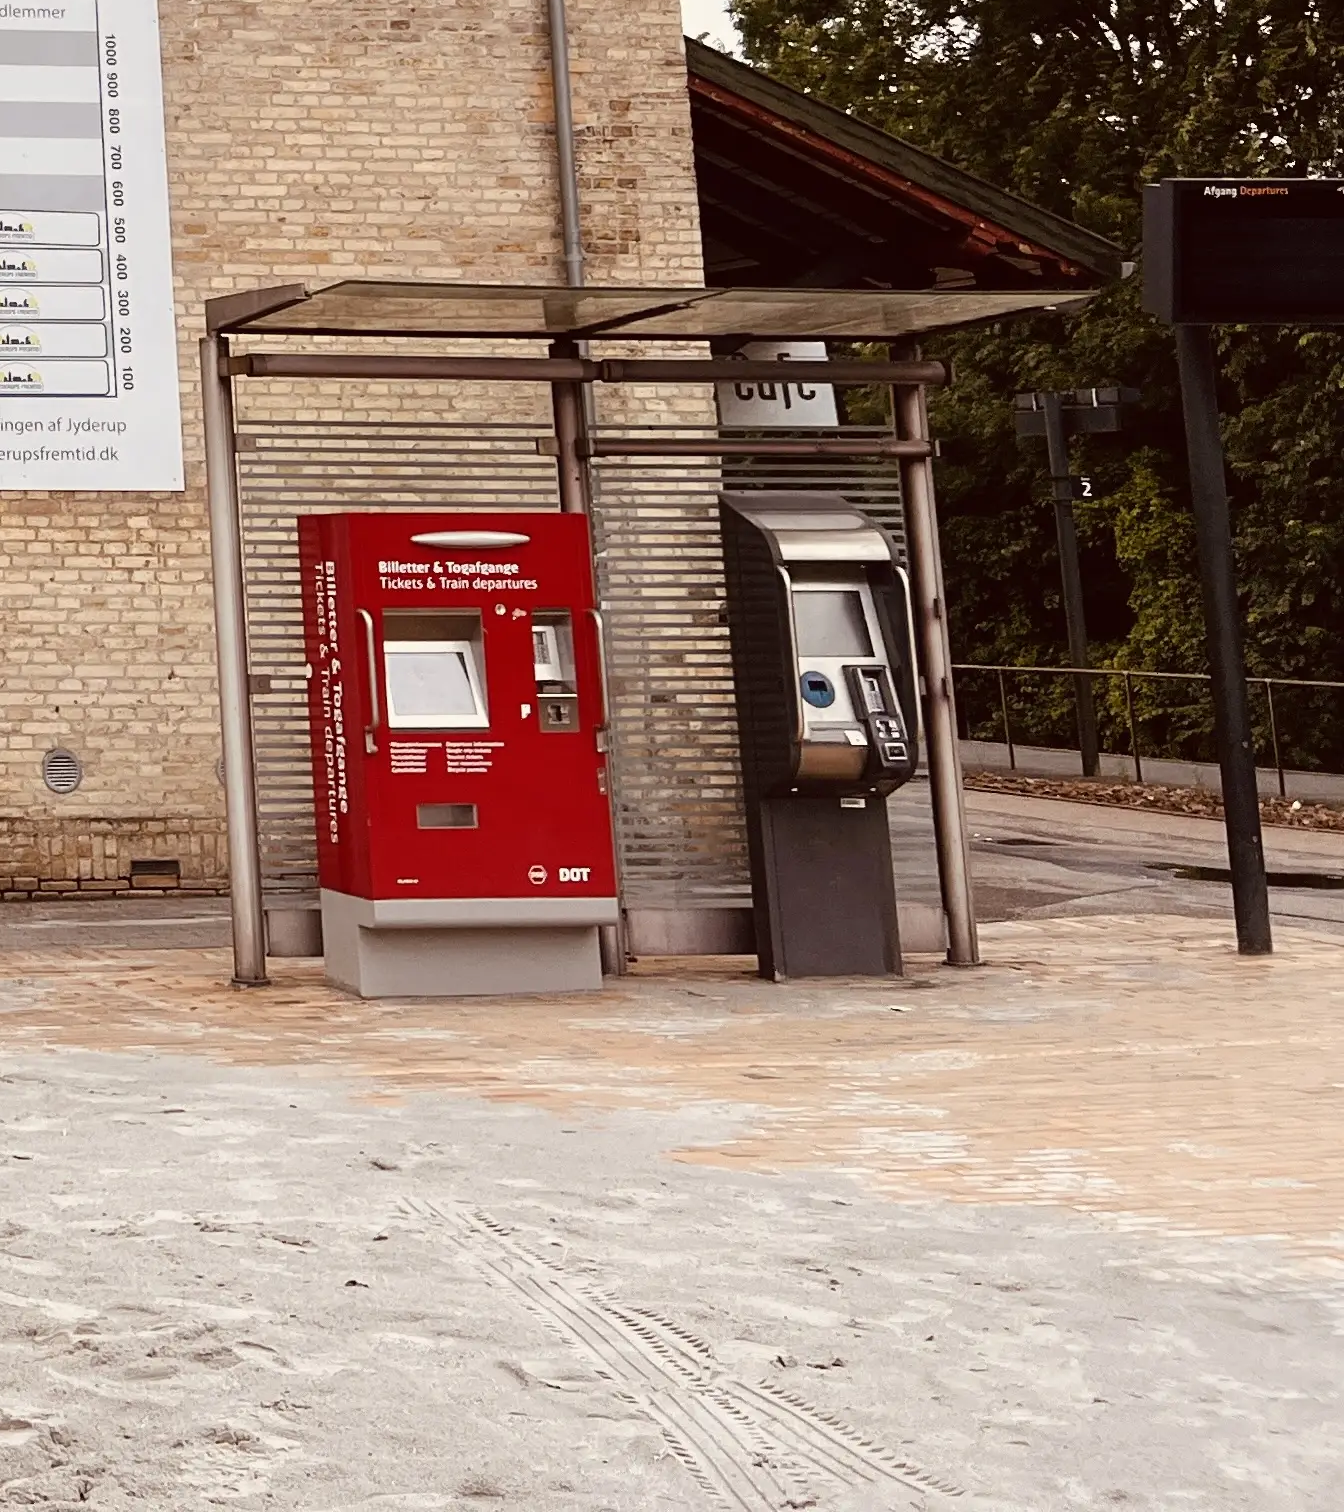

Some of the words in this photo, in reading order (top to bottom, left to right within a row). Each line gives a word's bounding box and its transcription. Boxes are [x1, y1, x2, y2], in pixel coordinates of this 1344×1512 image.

[105, 34, 116, 66] 1000
[107, 72, 118, 98] 900
[109, 108, 120, 134] 800
[111, 145, 122, 170] 700
[112, 181, 124, 206] 600
[1204, 186, 1237, 198] Afgang
[1240, 186, 1288, 196] Departures
[114, 217, 125, 243] 500
[116, 254, 127, 280] 400
[118, 291, 129, 316] 300
[120, 328, 132, 353] 200
[122, 367, 134, 390] 100
[48, 417, 63, 432] af
[66, 418, 126, 435] Jyderup
[1081, 482, 1092, 496] 2
[378, 561, 430, 573] Billetter
[433, 561, 443, 573] &
[445, 561, 519, 575] Togafgange
[380, 576, 423, 589] Tickets
[426, 576, 435, 589] &
[439, 576, 469, 589] Train
[472, 577, 538, 592] departures
[315, 561, 326, 635] Tickets
[326, 561, 338, 652] Billetter
[332, 658, 341, 675] &
[320, 644, 328, 658] &
[321, 667, 332, 718] Train
[324, 726, 338, 843] departures
[559, 868, 591, 882] DOT
